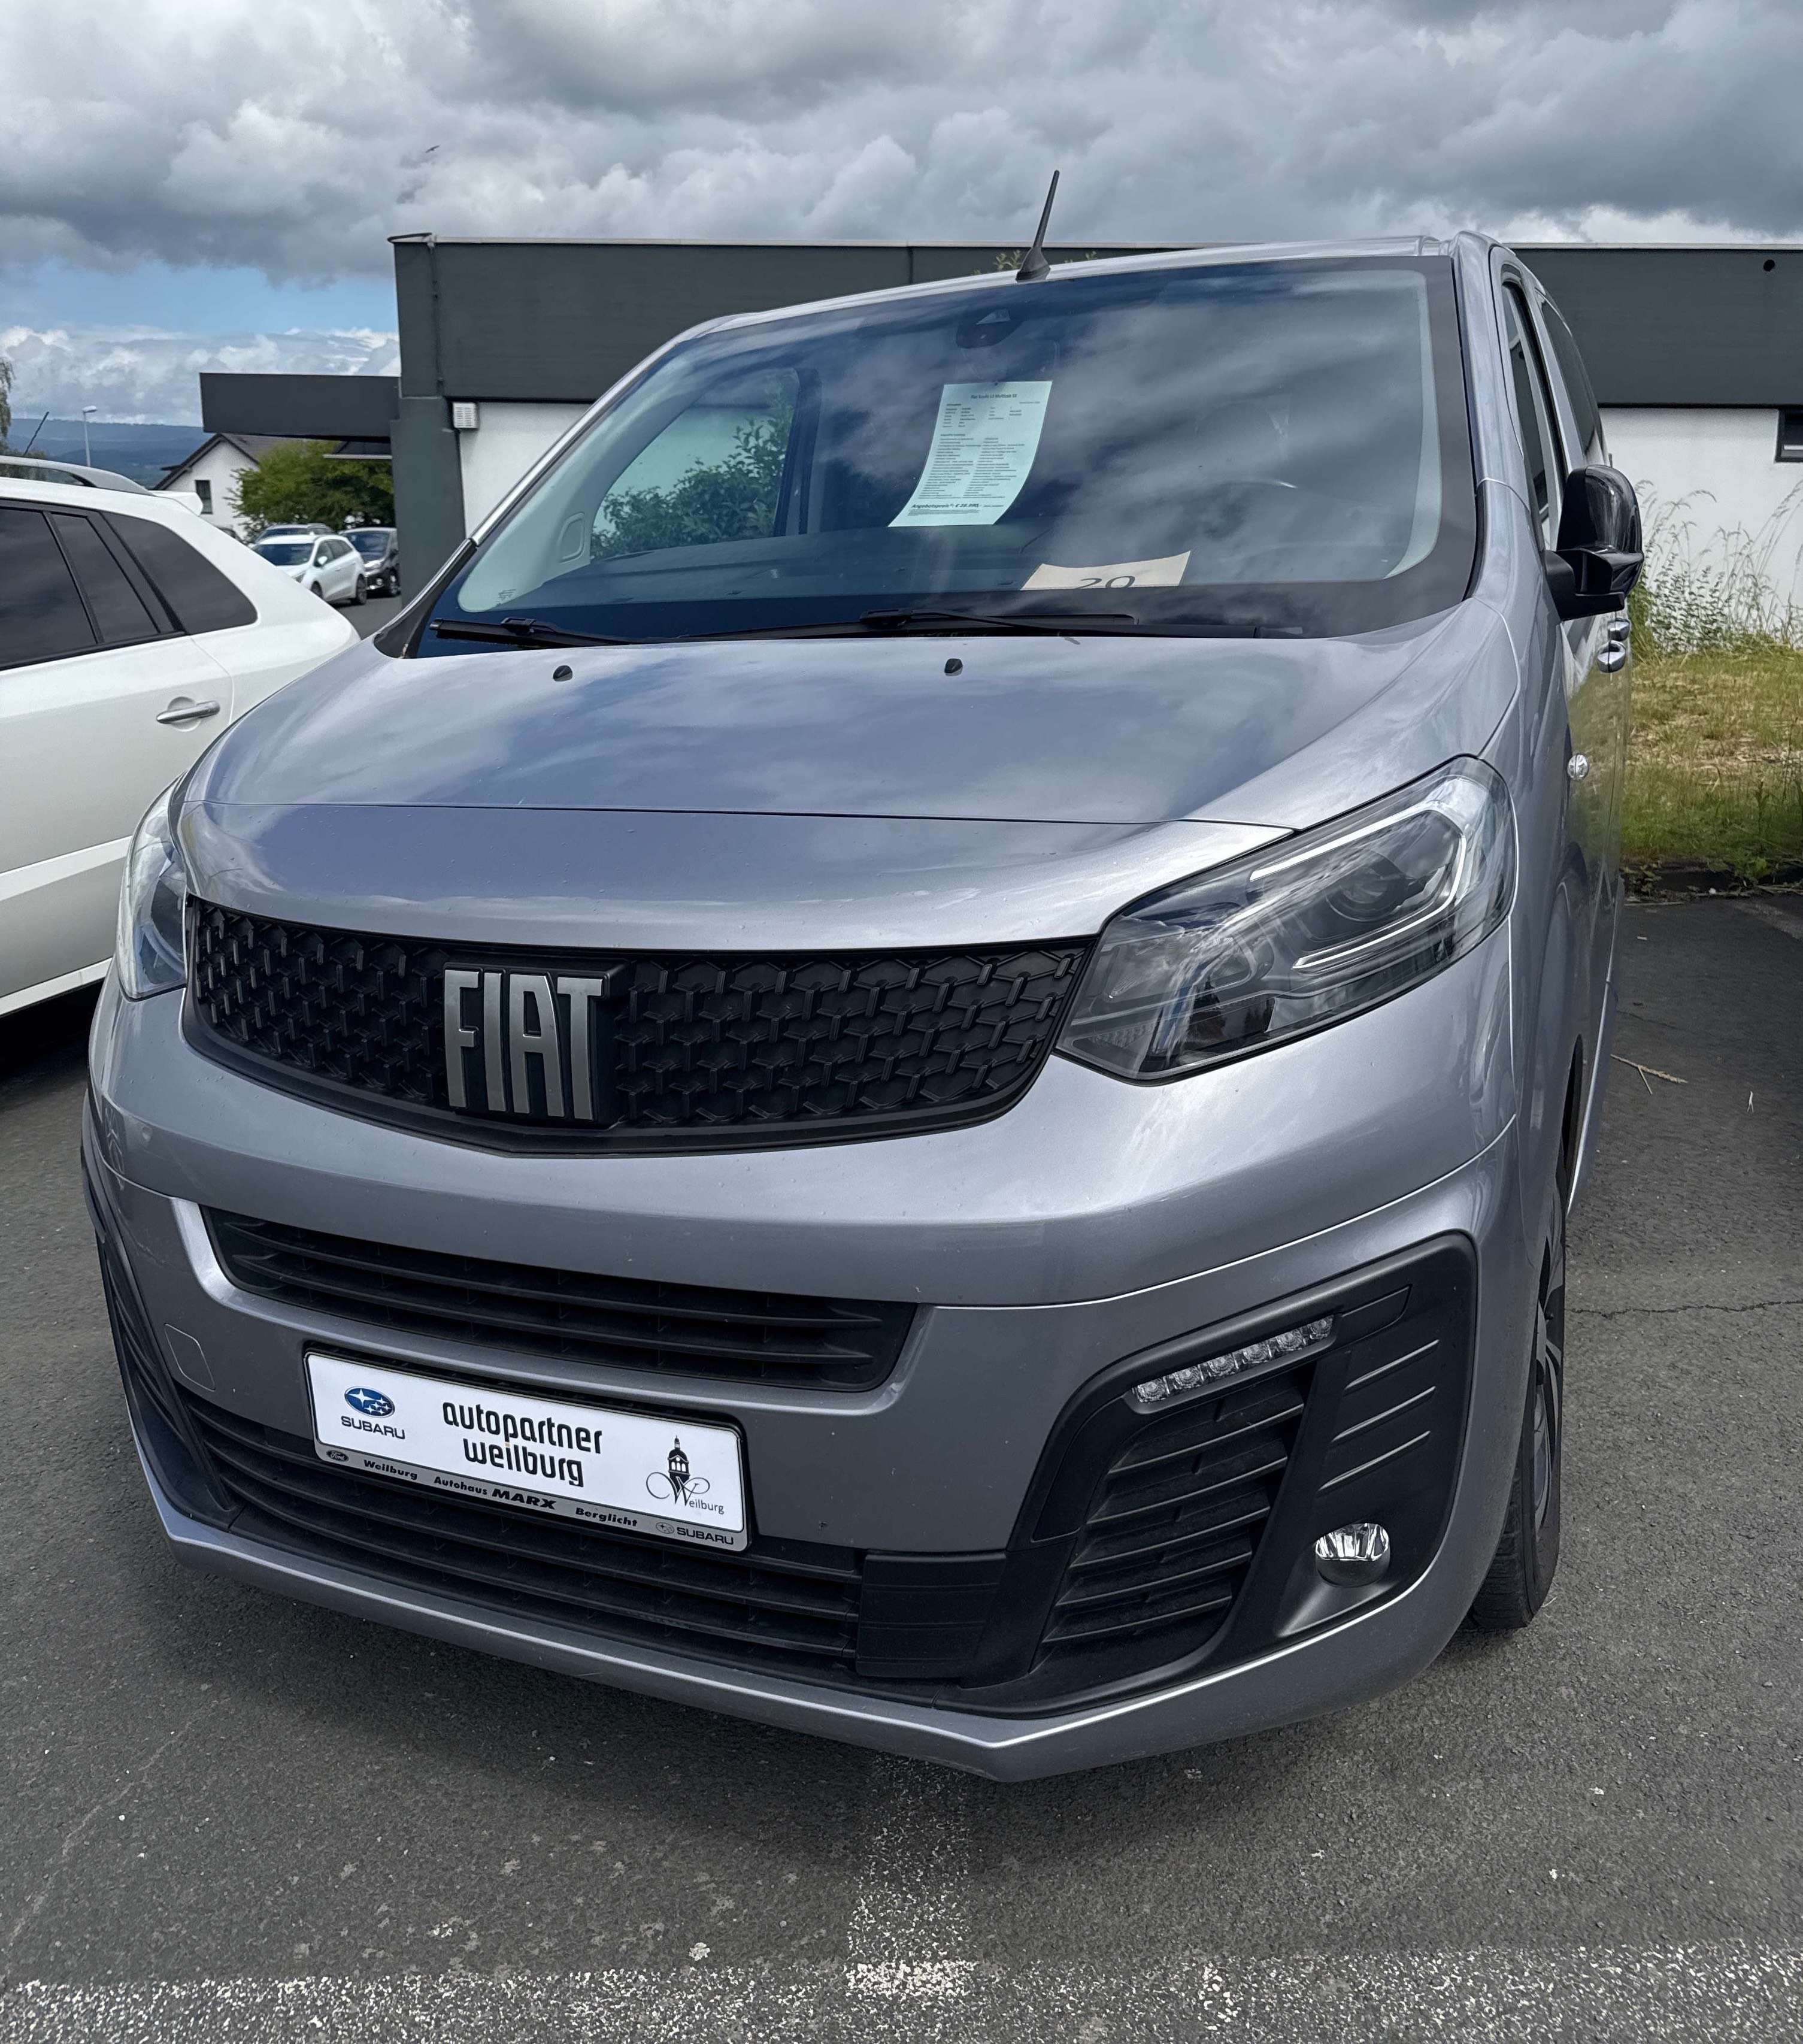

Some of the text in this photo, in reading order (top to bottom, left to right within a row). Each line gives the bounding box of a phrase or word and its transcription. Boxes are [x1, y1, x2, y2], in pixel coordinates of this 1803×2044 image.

[444, 970, 602, 1120] FIAT
[341, 1415, 405, 1440] SUBARU
[443, 1401, 602, 1454] autopartner
[463, 1438, 584, 1487] weilburg
[329, 1451, 734, 1545] Ford Weilburg Autohaus MARX Berglicht SUBARU
[646, 1471, 725, 1515] Weilburg
